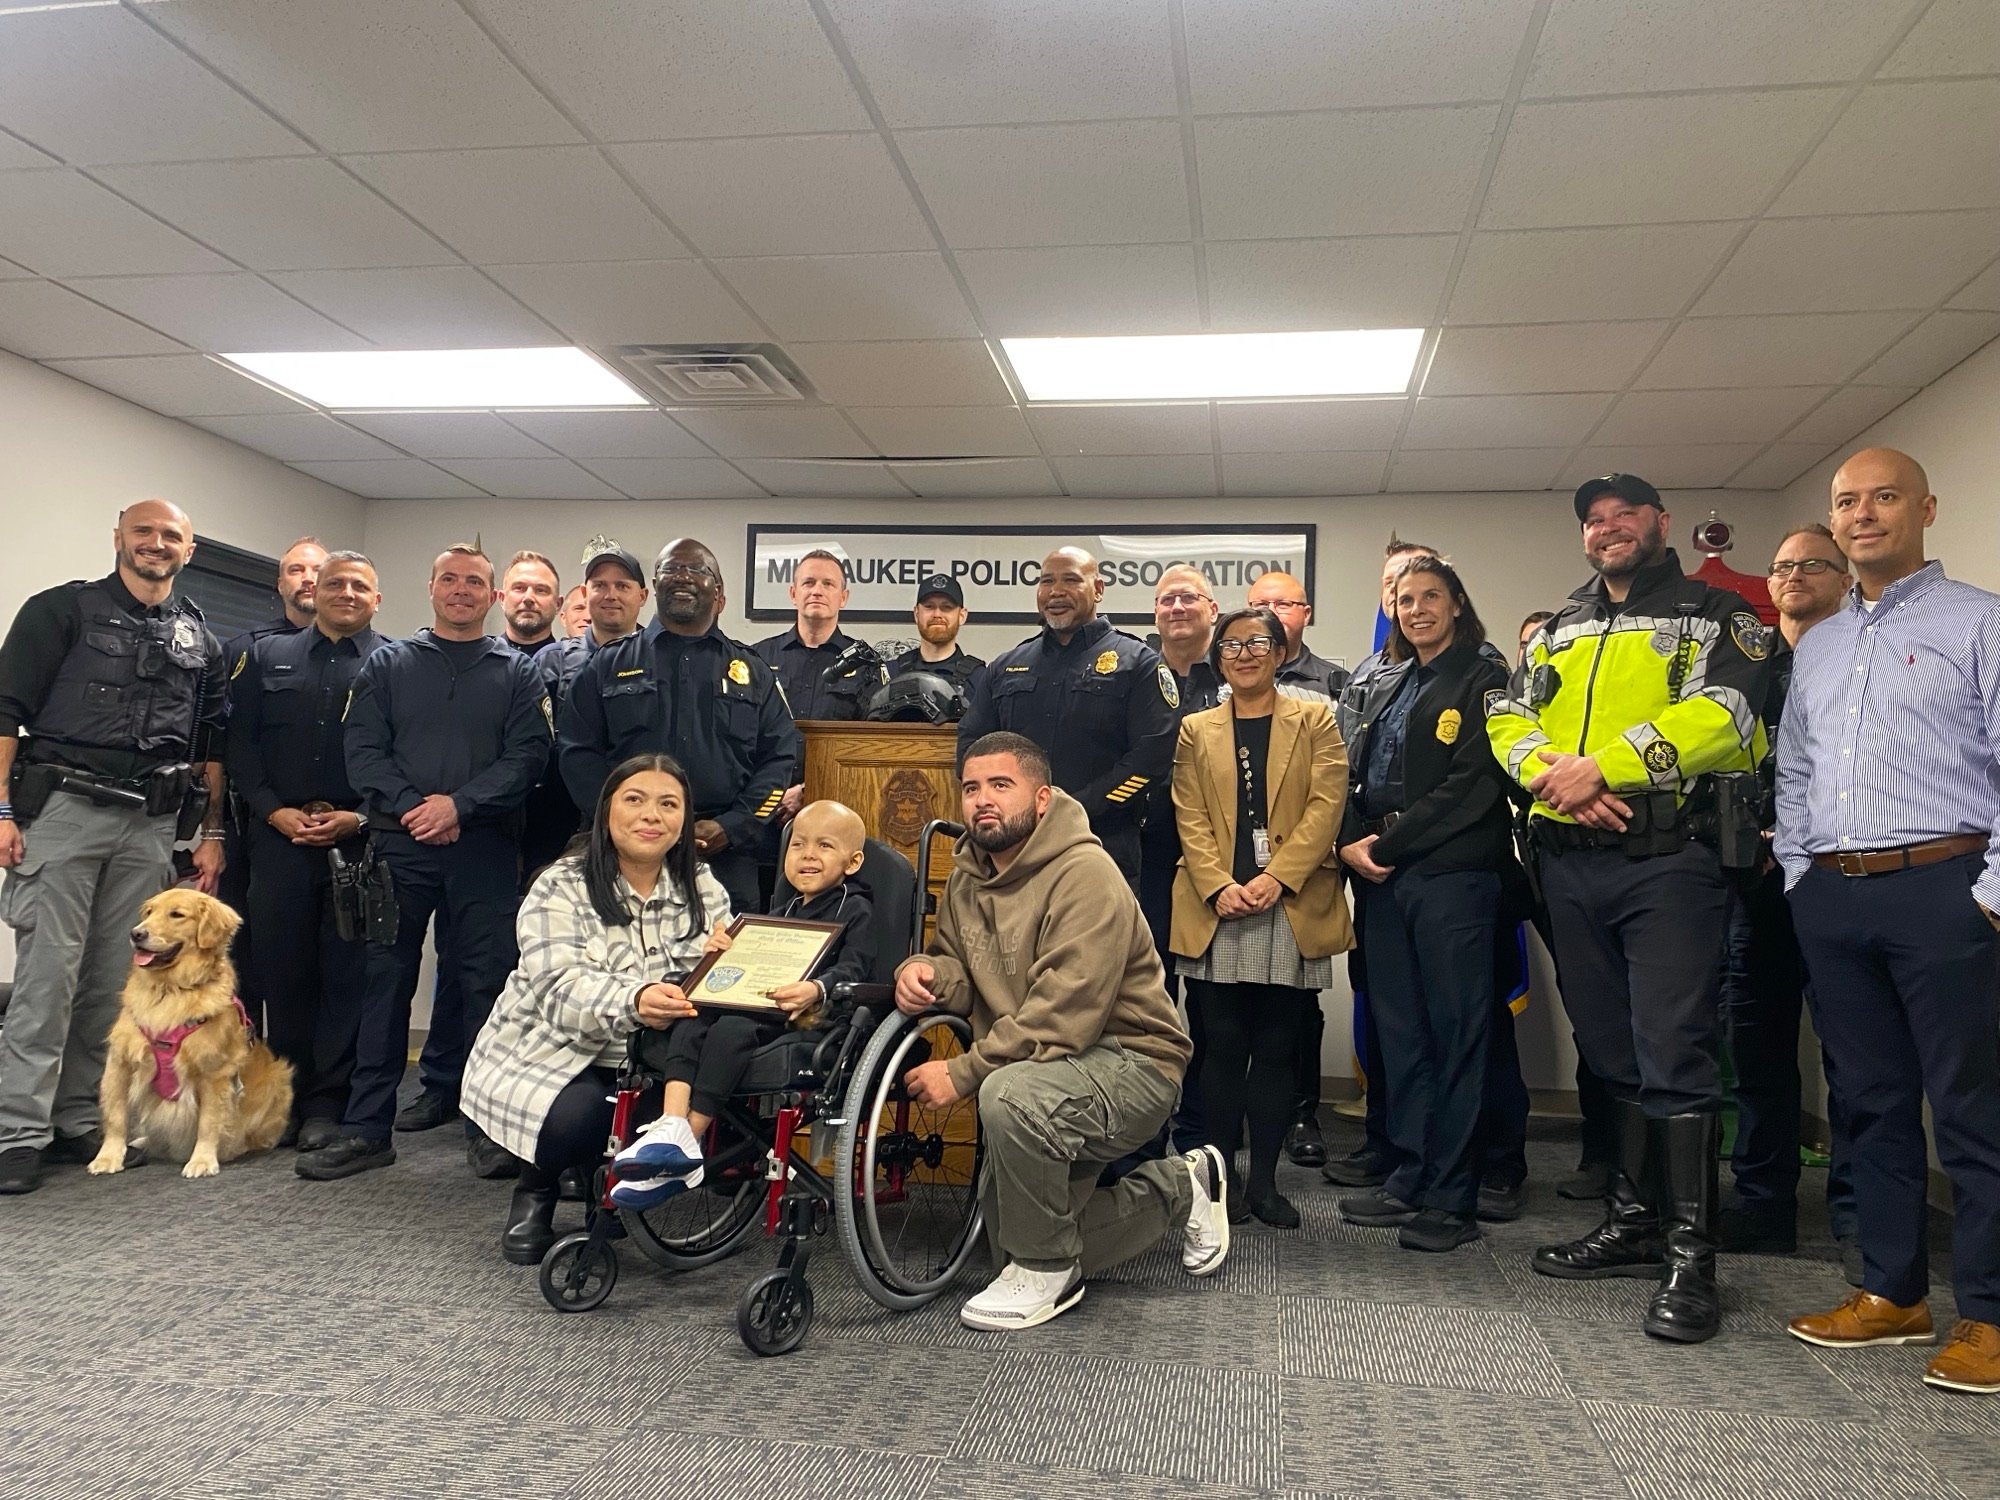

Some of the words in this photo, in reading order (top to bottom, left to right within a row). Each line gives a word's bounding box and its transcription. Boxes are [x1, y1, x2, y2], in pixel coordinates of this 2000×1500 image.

[767, 558, 935, 585] MIAUKEE
[952, 560, 1042, 586] POLIC
[1097, 560, 1291, 587] SSOATION
